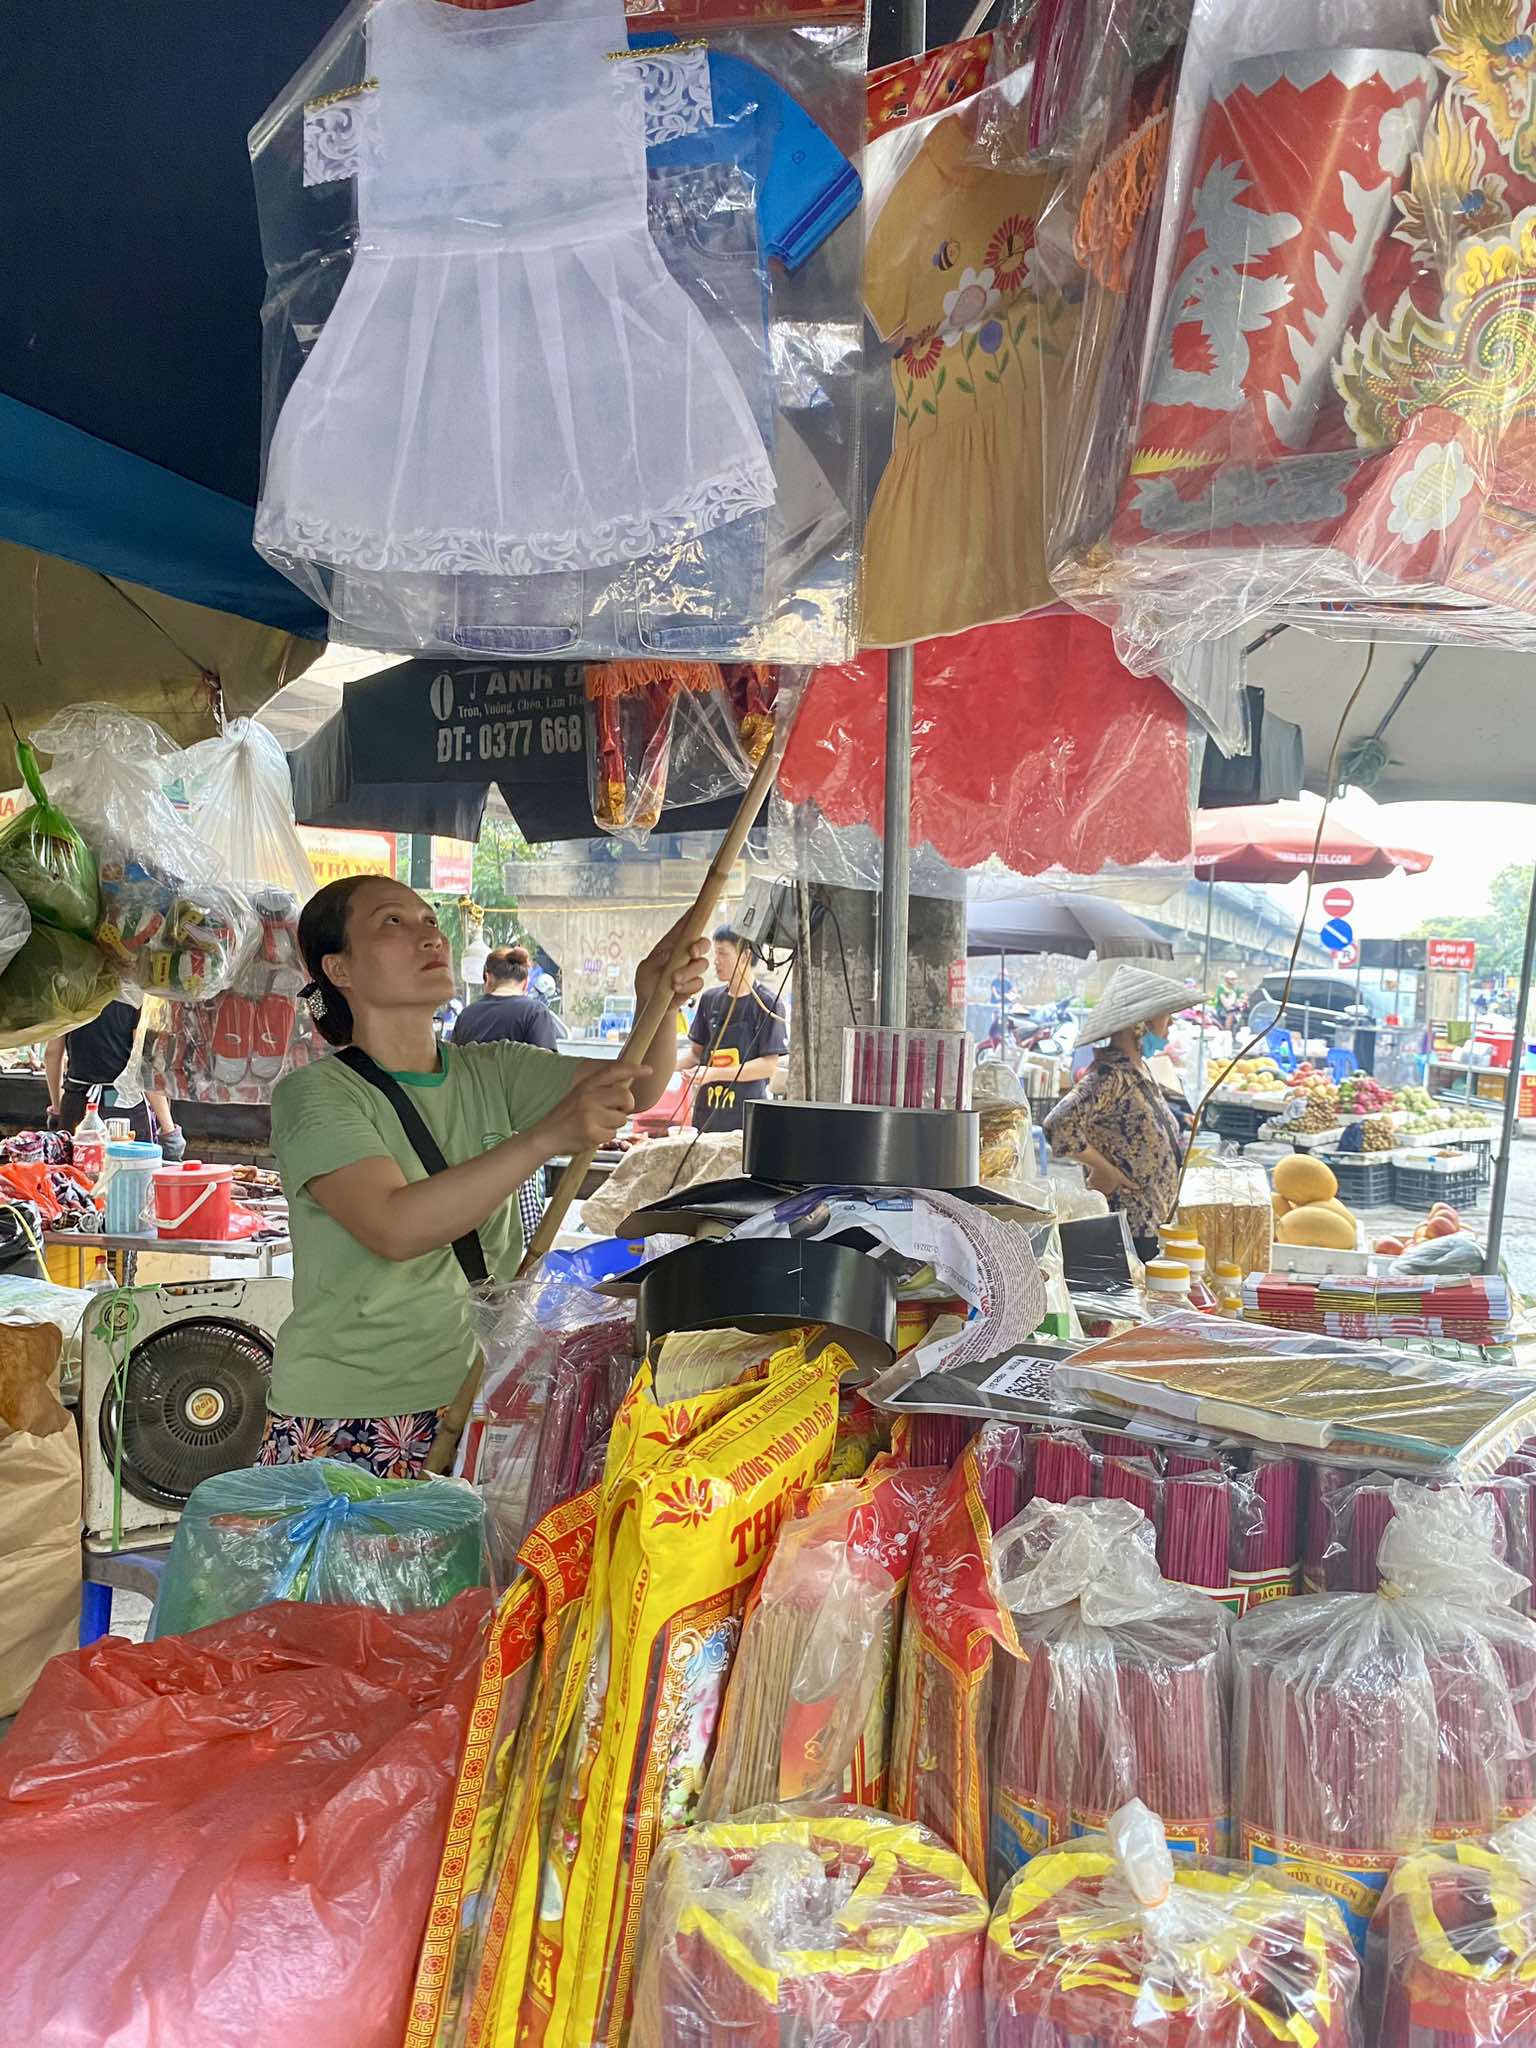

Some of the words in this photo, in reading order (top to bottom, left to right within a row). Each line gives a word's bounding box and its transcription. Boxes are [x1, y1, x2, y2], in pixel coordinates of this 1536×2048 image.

[486, 668, 553, 696] ANH
[437, 725, 472, 763] ĐT:
[479, 720, 533, 760] 0377
[540, 714, 584, 755] 668
[725, 1457, 775, 1496] HƯƠNG
[792, 1413, 820, 1444] CAO
[813, 1400, 836, 1428] CẤP
[635, 1568, 648, 1601] CAO
